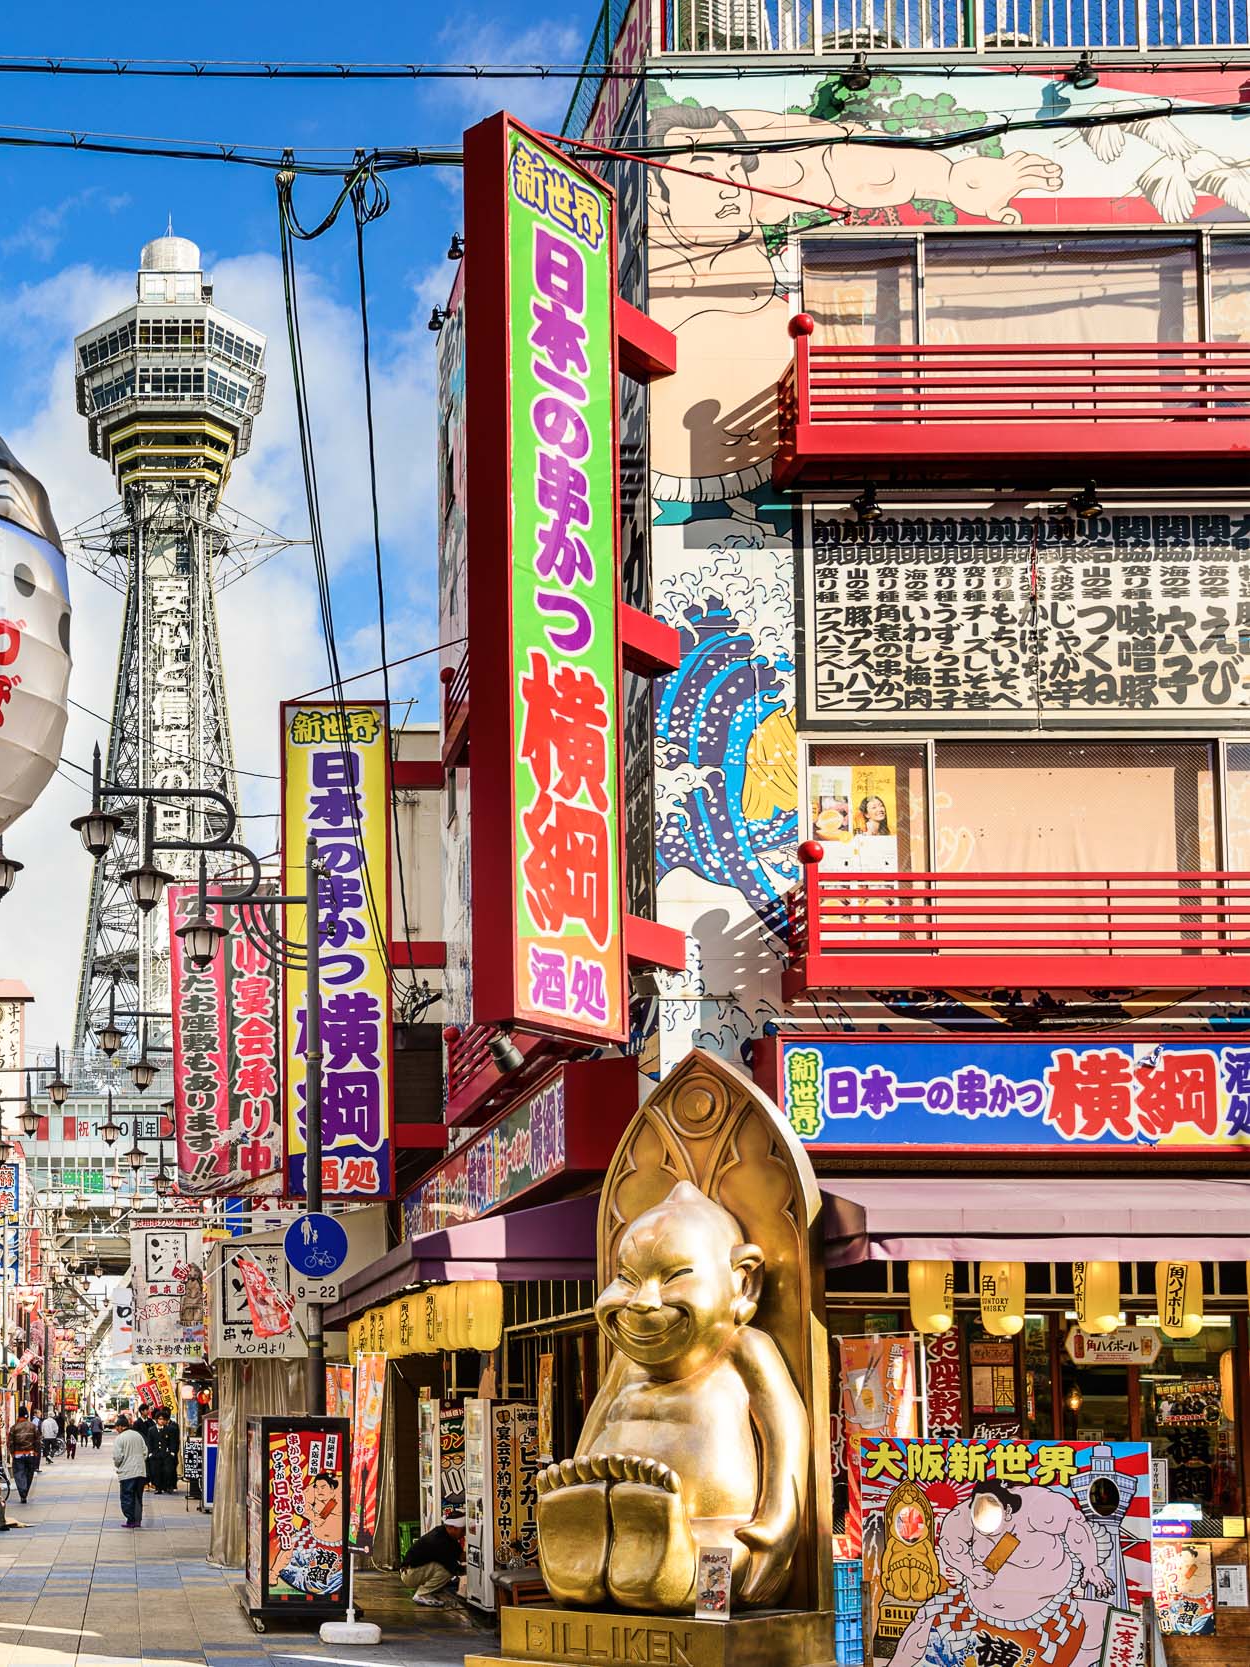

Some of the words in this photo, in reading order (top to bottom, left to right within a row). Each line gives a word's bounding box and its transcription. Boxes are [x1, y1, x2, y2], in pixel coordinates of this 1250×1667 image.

[514, 143, 602, 246] 新世界
[292, 712, 381, 744] 新世界
[529, 945, 607, 1023] 酒処
[789, 1053, 821, 1136] 新世界
[981, 1275, 997, 1297] 角
[1167, 1265, 1186, 1326] 角ハイボール
[1086, 1339, 1139, 1352] 角ハイボール
[866, 1442, 1078, 1486] 大阪新世界
[525, 1620, 693, 1666] BILLIKEN
